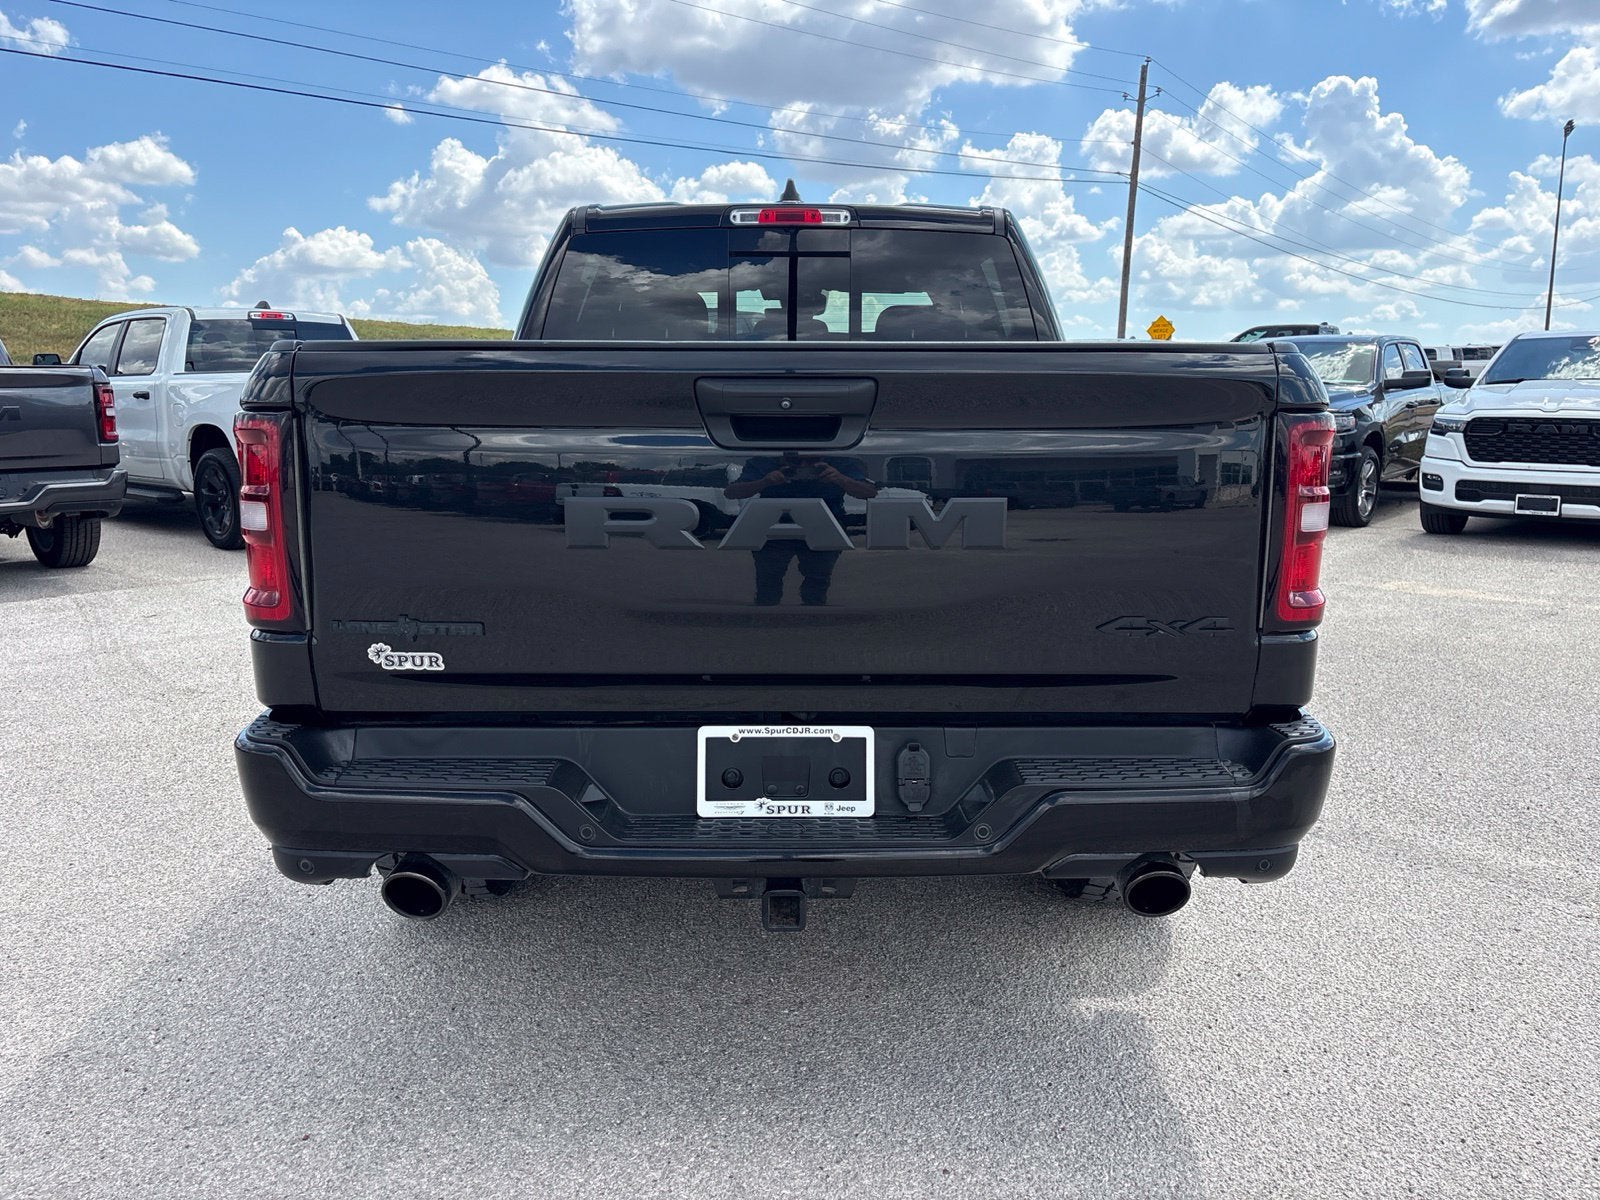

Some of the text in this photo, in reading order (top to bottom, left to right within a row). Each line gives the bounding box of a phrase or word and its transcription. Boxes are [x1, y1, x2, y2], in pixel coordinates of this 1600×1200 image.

[1507, 423, 1588, 434] RAM
[564, 497, 1008, 550] RAM
[384, 655, 442, 668] SPUR
[738, 727, 834, 736] www.SpurCDJR.com
[766, 805, 812, 815] SPUR
[836, 804, 856, 813] Jeep
